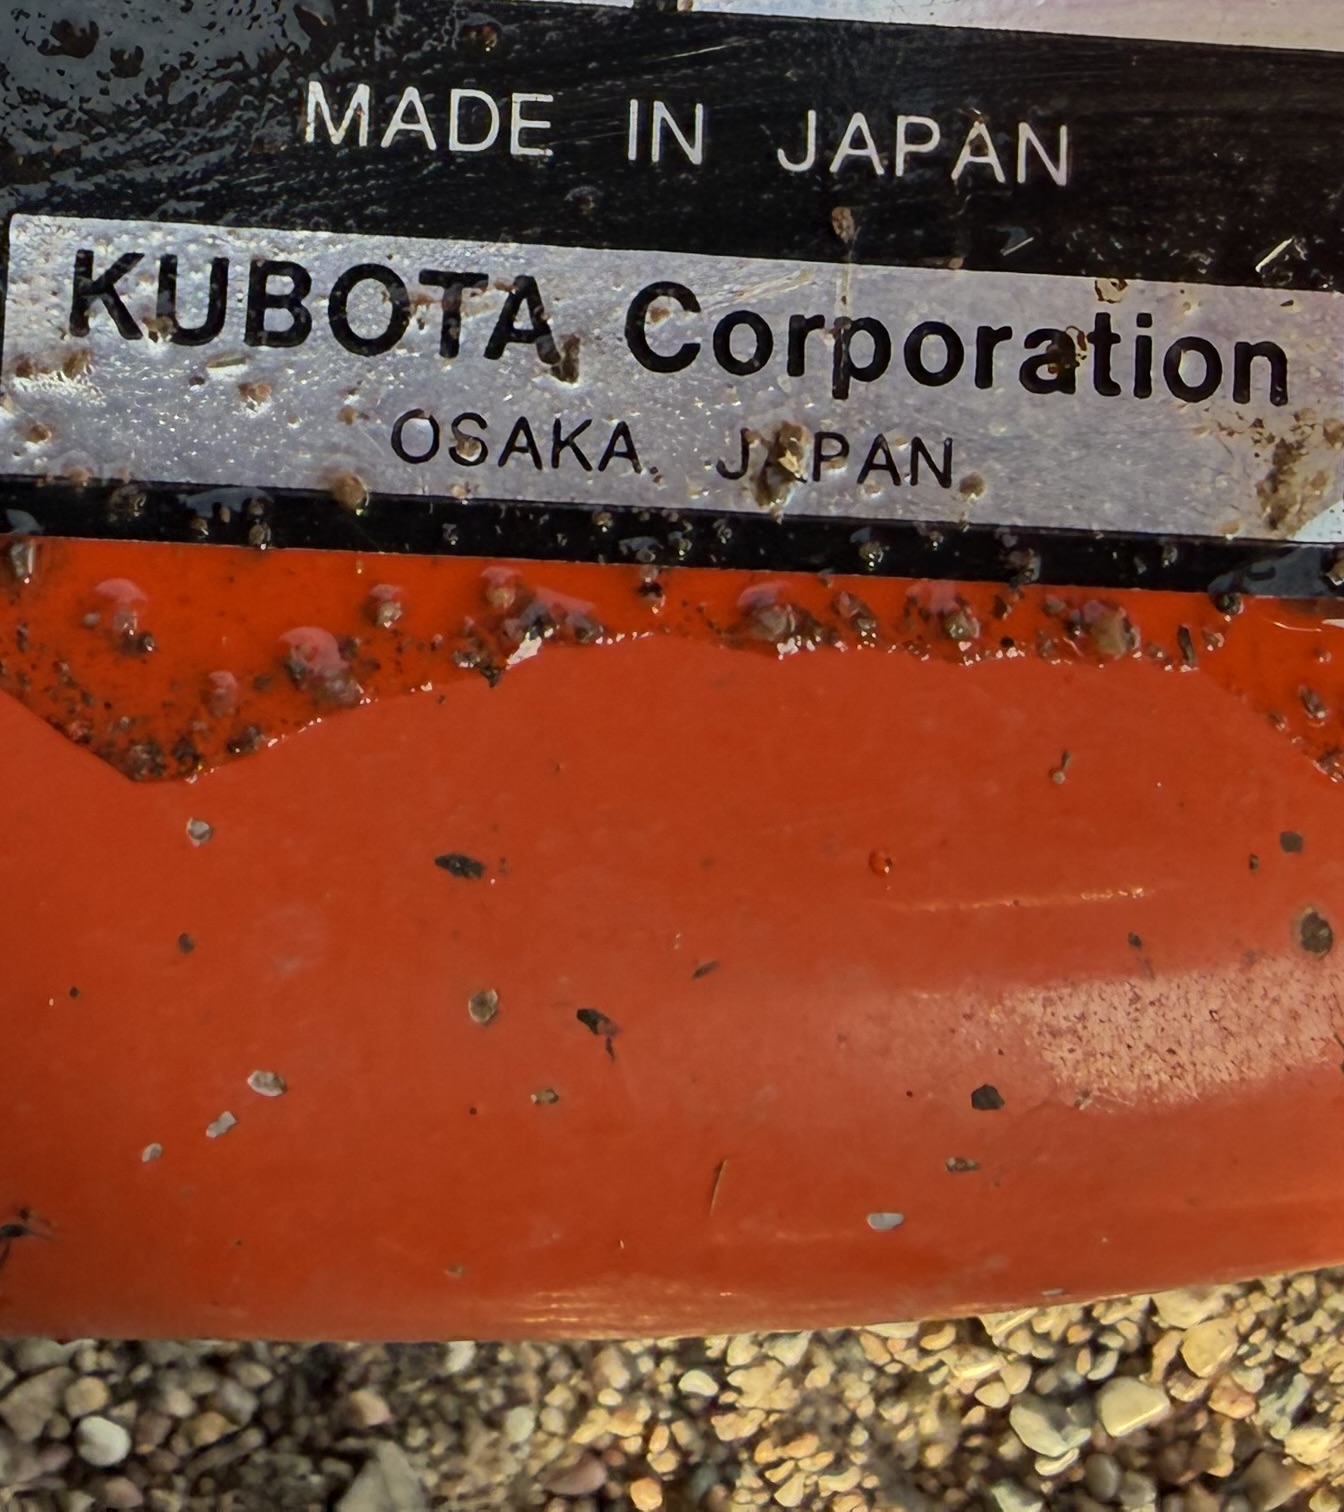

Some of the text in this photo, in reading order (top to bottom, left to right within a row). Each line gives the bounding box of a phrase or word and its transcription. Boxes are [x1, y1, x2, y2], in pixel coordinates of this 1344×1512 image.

[304, 80, 1070, 187] MADE IN JAPAN
[67, 249, 1289, 408] KUBOTA Corporation
